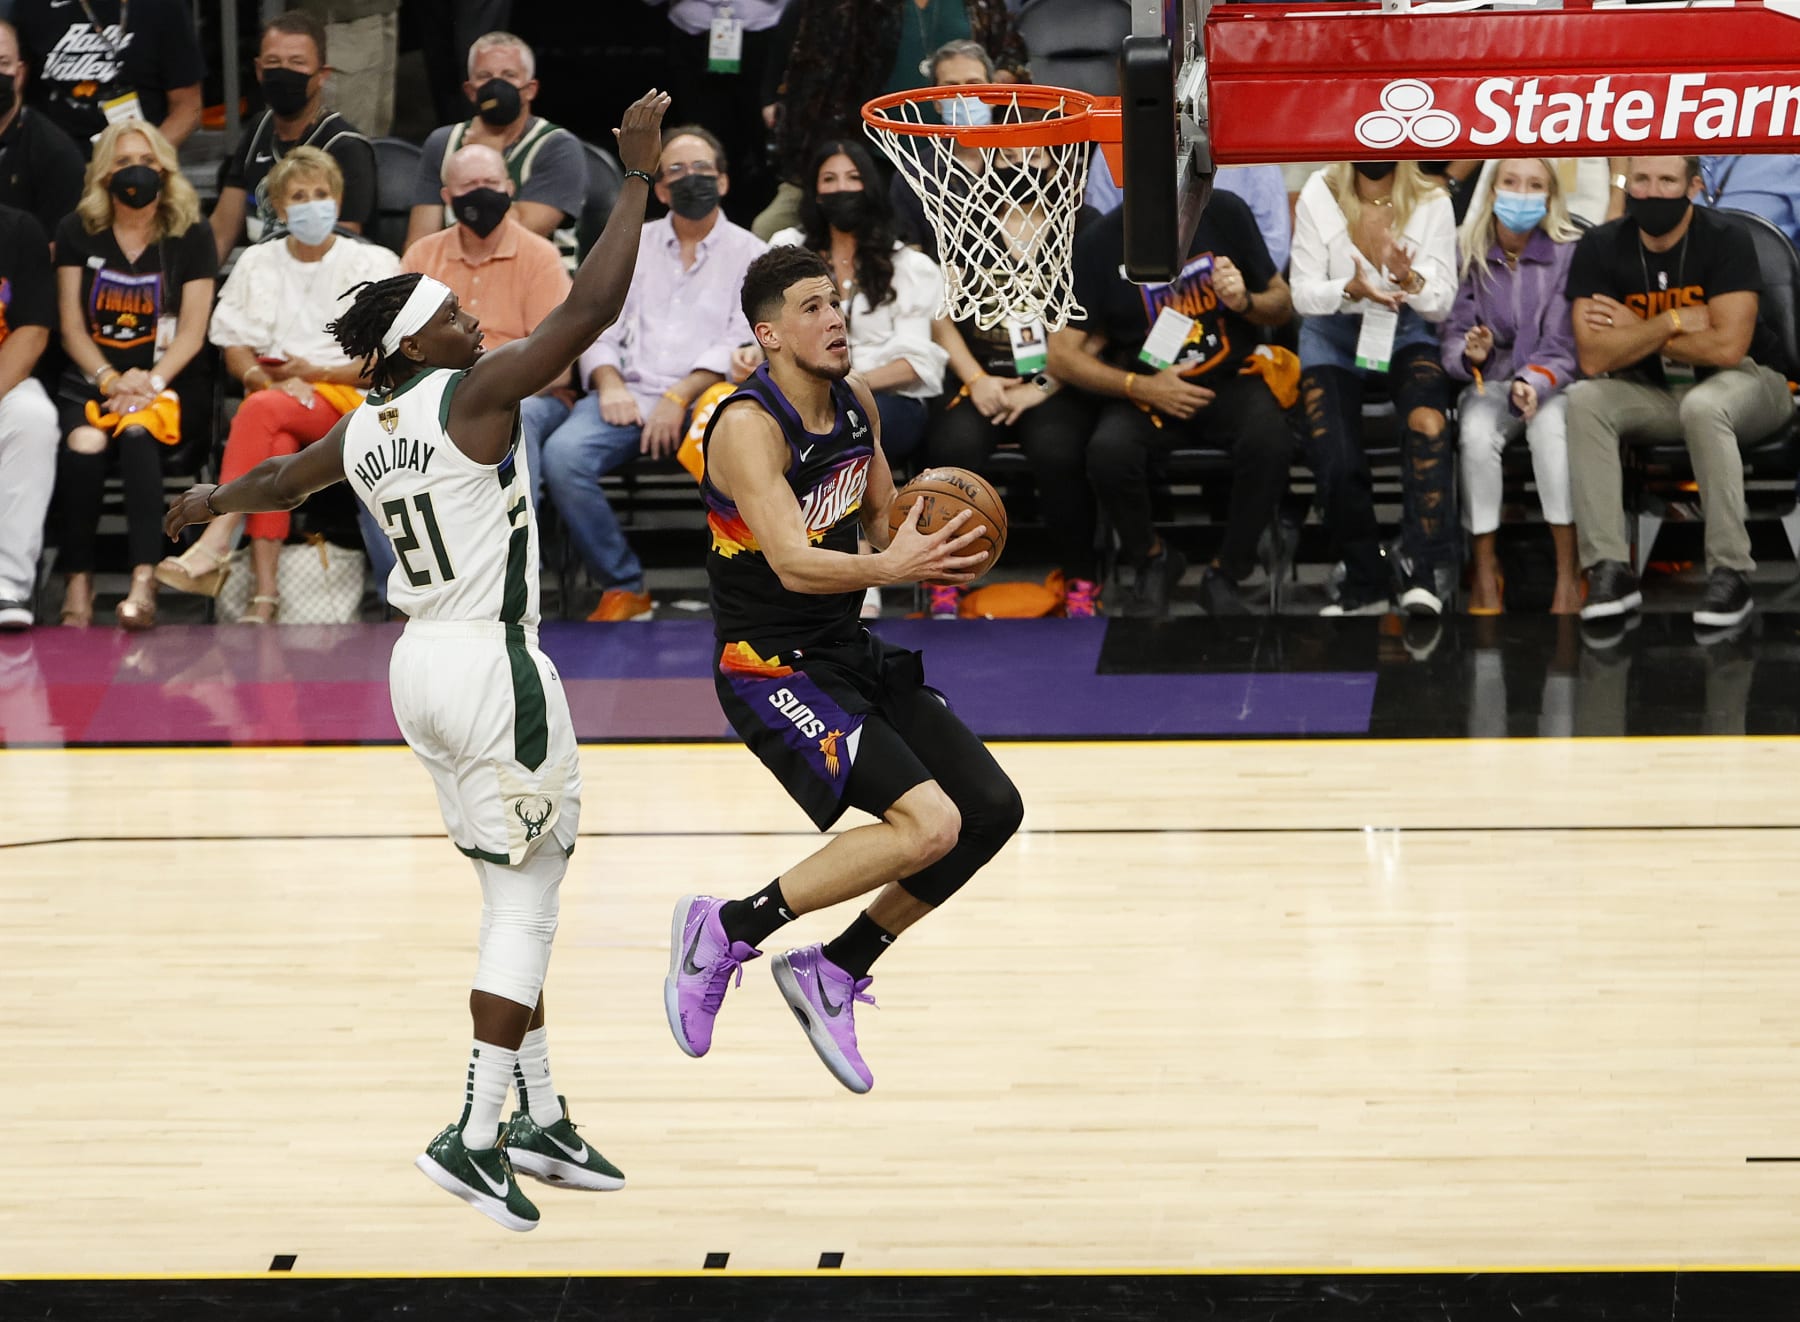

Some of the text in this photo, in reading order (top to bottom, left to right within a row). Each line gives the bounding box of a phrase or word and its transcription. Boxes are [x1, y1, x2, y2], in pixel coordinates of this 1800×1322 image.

[852, 424, 868, 440] PayPal
[355, 438, 435, 492] HOLIDAY
[823, 478, 837, 497] THE
[380, 491, 456, 588] 21
[768, 687, 826, 739] SUNS
